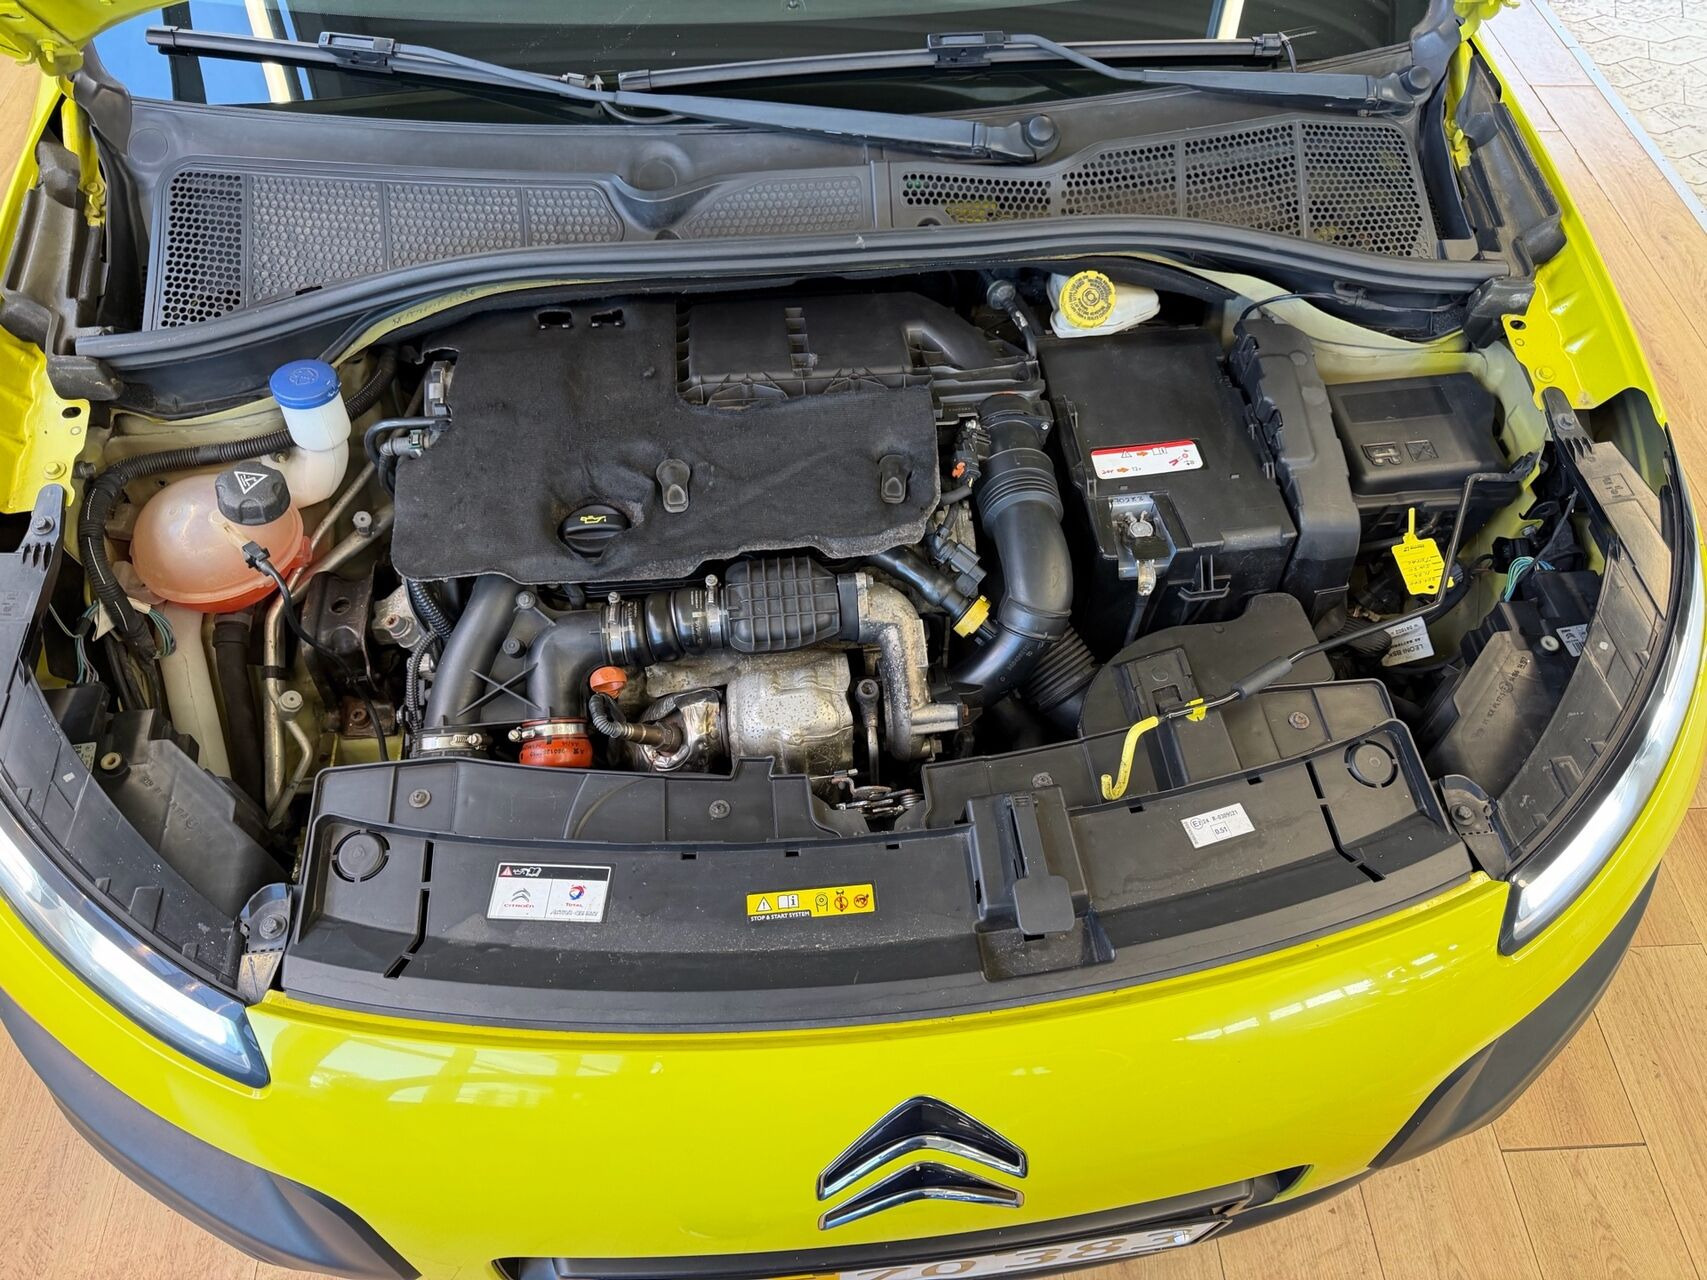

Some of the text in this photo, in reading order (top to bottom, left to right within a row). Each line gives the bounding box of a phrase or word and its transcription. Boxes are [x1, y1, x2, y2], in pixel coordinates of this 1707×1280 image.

[1403, 643, 1424, 654] LEONI
[789, 910, 811, 918] SYSTEM
[856, 1228, 1193, 1280] 70 383
